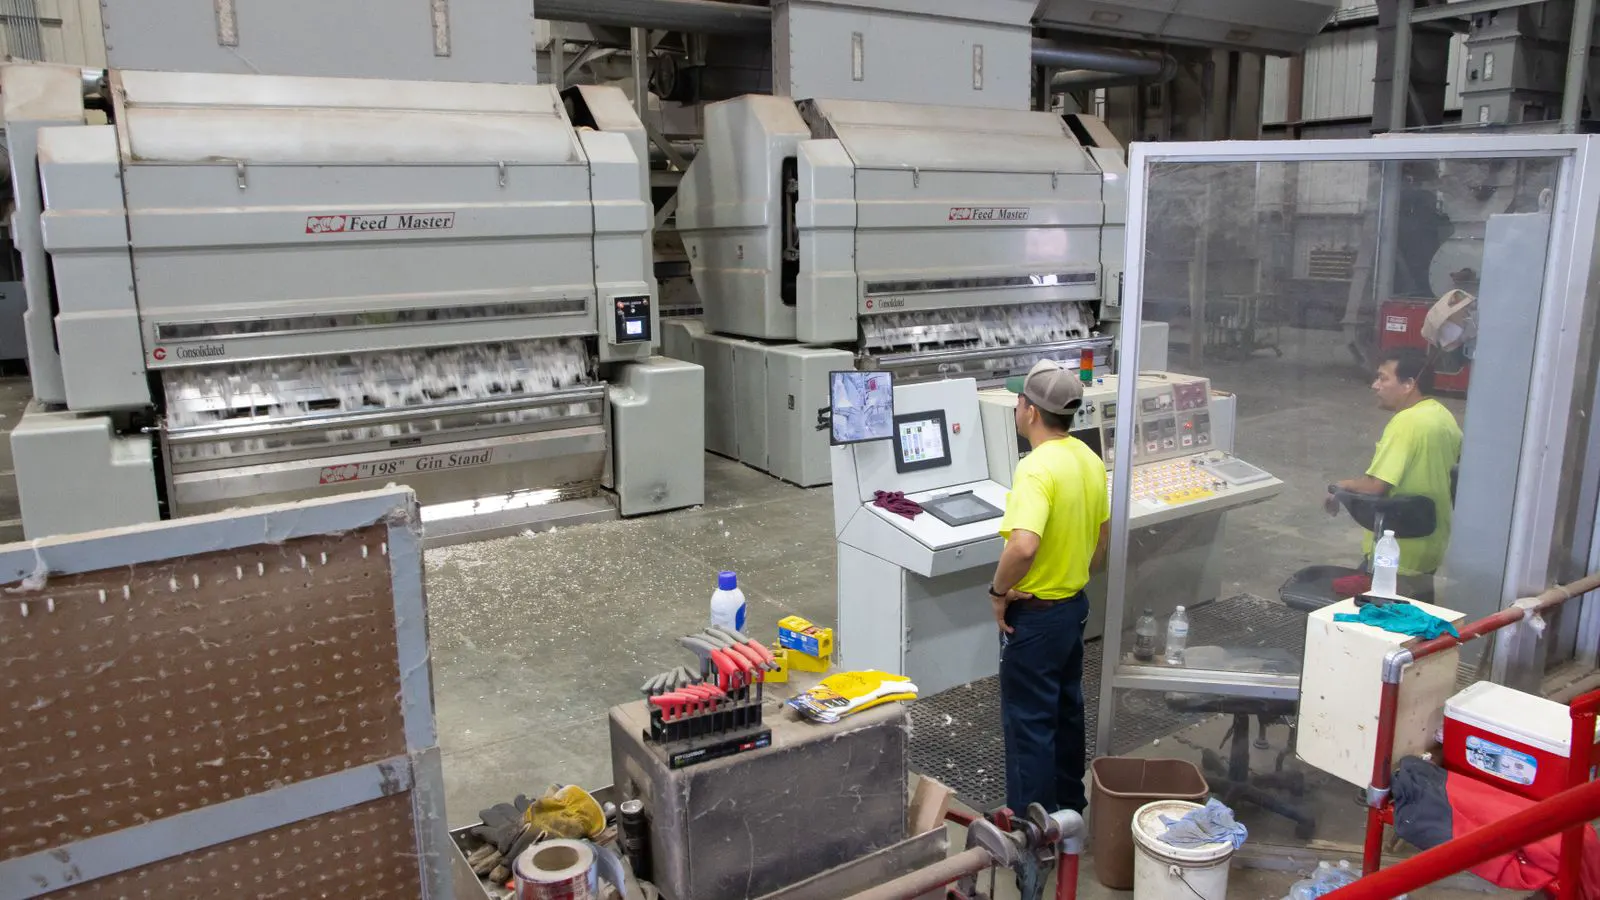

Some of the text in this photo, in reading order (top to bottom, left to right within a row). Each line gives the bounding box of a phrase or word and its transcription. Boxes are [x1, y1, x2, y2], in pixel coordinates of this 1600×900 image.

[972, 208, 1027, 219] Feed Master
[350, 214, 451, 230] Feed Master
[176, 343, 225, 359] Consolidated
[415, 456, 443, 471] Gin
[447, 450, 489, 467] Stand
